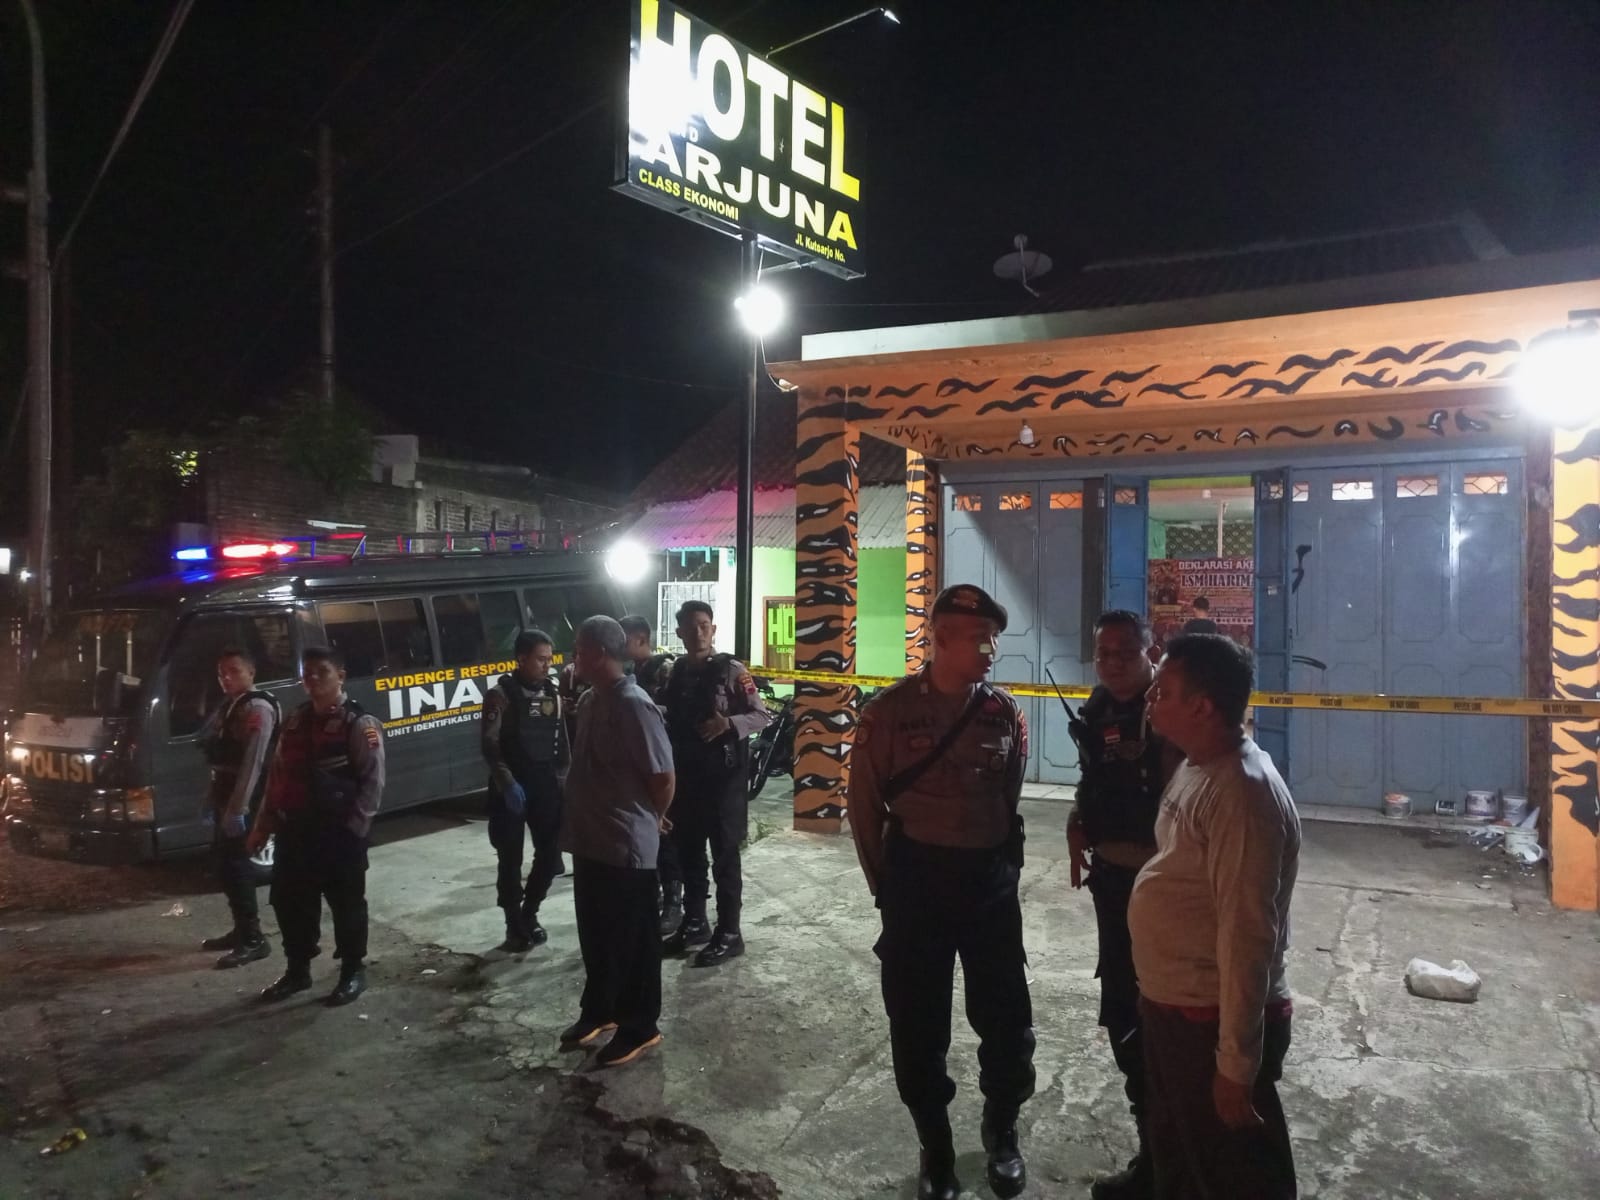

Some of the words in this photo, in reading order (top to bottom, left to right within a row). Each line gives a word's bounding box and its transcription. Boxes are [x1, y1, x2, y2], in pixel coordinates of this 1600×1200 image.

[640, 0, 861, 202] HOTEL
[638, 168, 681, 197] CLASS
[683, 186, 739, 221] EKONOMI
[639, 129, 858, 250] ARJUNA
[1178, 559, 1233, 570] DEKLARASI
[1208, 572, 1254, 587] HARIM
[768, 607, 796, 646] HO
[375, 668, 455, 691] EVIDENCE
[460, 660, 519, 680] RESPON
[387, 725, 412, 738] UNIT
[413, 714, 472, 733] IDENTIFIKASI
[20, 749, 95, 784] POLISI
